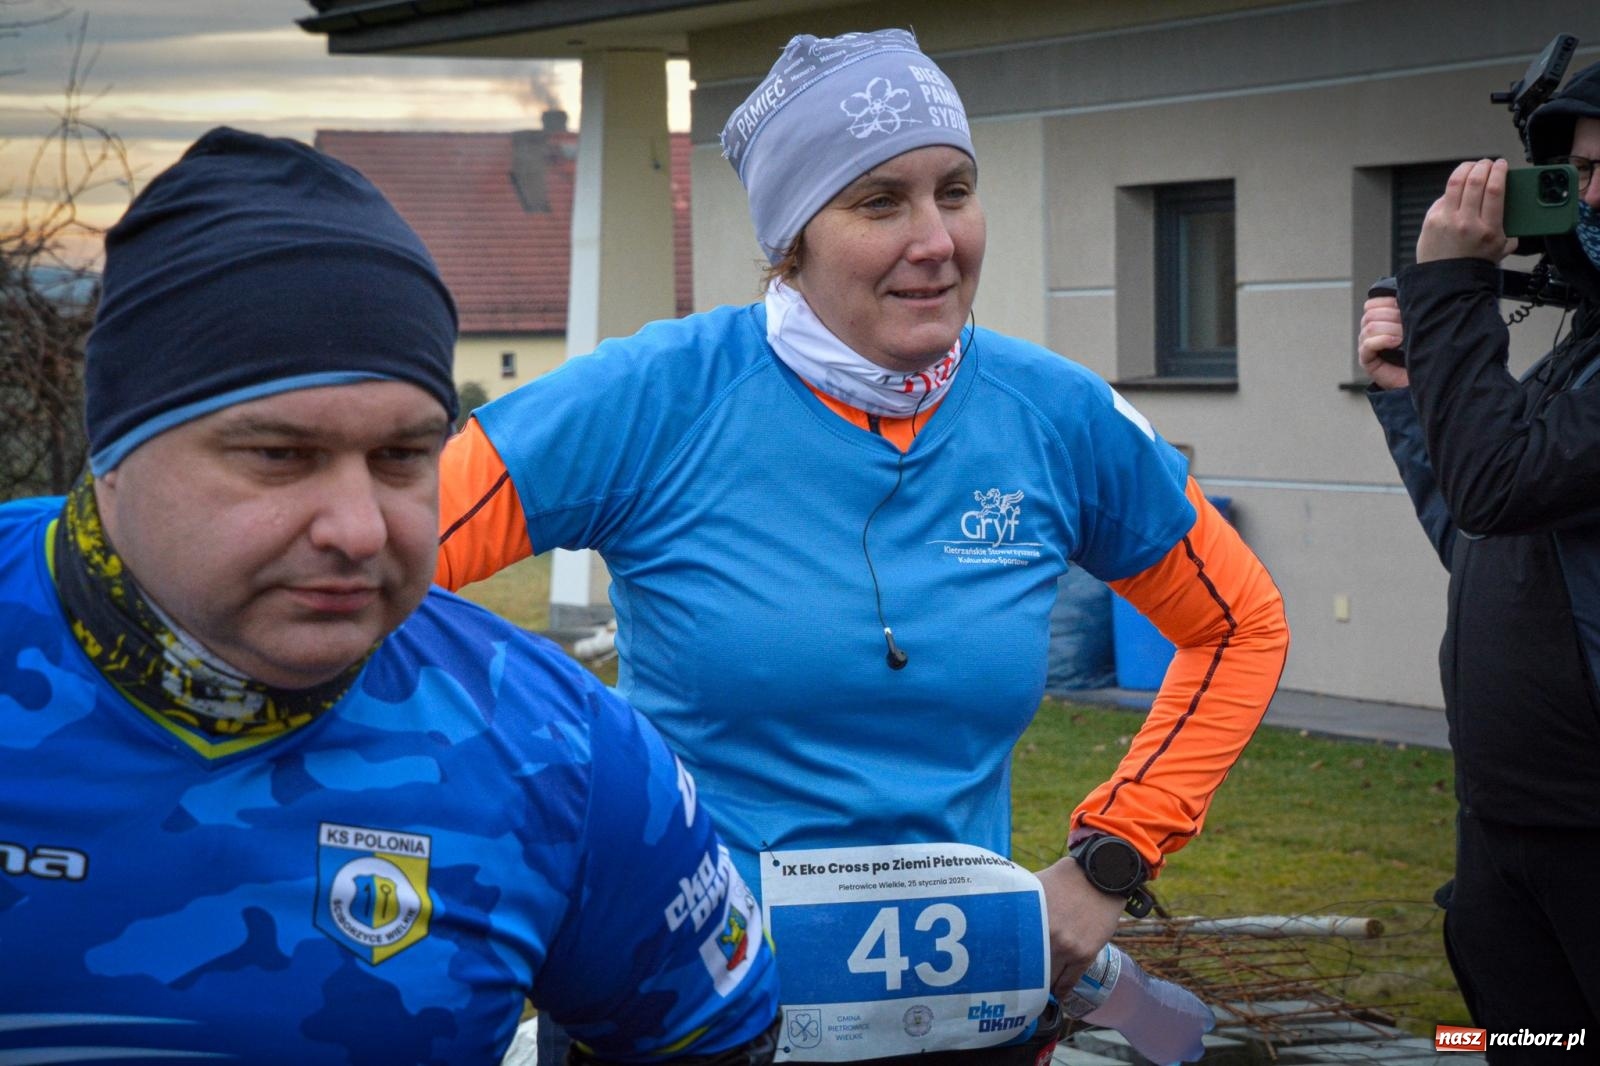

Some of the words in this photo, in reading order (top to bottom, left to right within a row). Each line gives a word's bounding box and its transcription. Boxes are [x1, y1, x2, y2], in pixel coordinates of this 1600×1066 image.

[961, 505, 1020, 548] Gryf
[326, 828, 349, 845] KS
[353, 832, 425, 855] POLONIA
[782, 864, 797, 876] IX
[800, 863, 826, 875] Eko
[828, 861, 870, 874] Cross
[872, 861, 890, 876] po
[892, 856, 931, 871] Ziemi
[838, 882, 877, 891] Pietrowice
[878, 880, 907, 890] Wielkie,
[908, 879, 917, 887] 25
[918, 877, 948, 888] stycznia
[949, 876, 966, 884] 2025
[847, 902, 970, 991] 43
[968, 1000, 1005, 1020] eko
